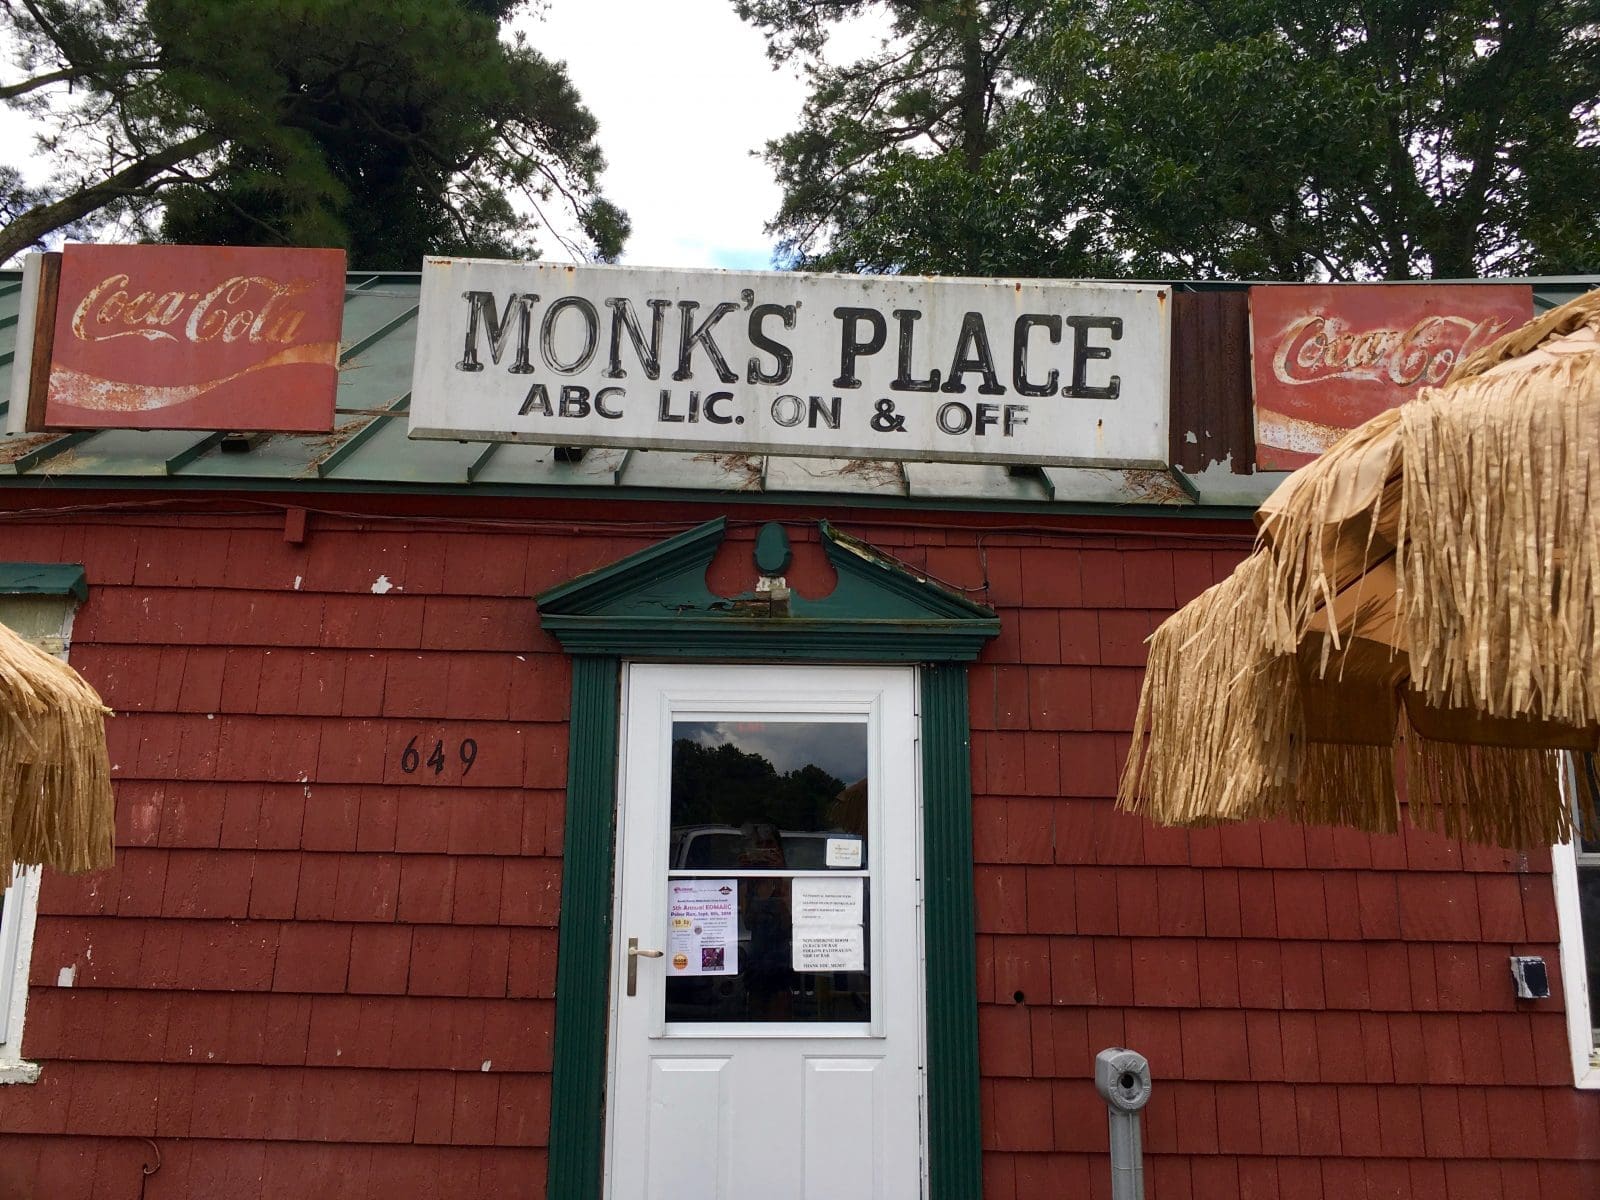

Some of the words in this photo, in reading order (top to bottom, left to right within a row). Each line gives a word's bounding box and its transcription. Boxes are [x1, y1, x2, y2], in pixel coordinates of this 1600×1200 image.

[71, 273, 318, 344] Coca-Cola
[455, 289, 800, 386] MONK'S
[832, 307, 1123, 400] PLACE
[1273, 315, 1513, 386] Coca-Col
[518, 383, 626, 419] ABC
[658, 390, 745, 425] LIC.
[770, 395, 842, 430] ON
[870, 398, 908, 433] &
[936, 402, 1029, 438] OFF
[401, 735, 478, 776] 649
